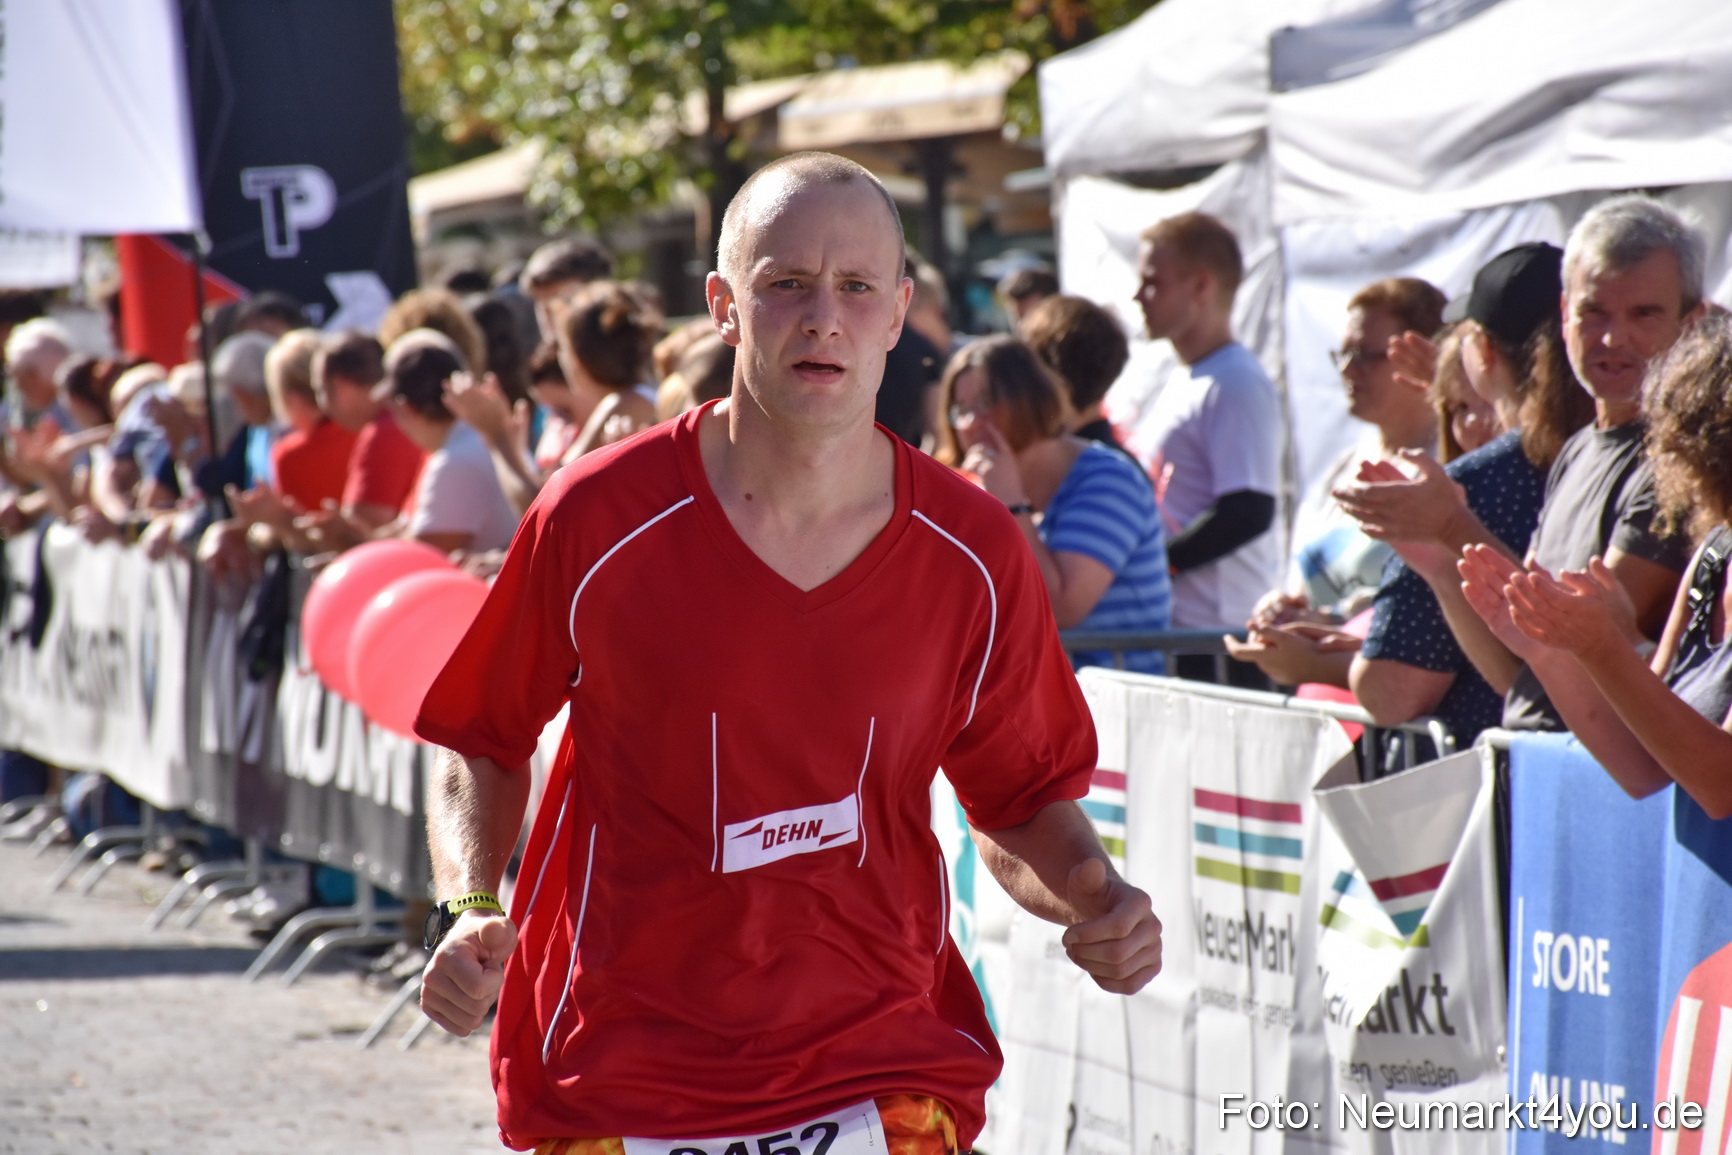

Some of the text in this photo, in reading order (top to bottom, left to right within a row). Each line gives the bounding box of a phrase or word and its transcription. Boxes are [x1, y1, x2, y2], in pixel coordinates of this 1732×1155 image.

[762, 819, 823, 851] DEHN
[1532, 930, 1611, 997] STORE
[1379, 1059, 1459, 1090] genießen
